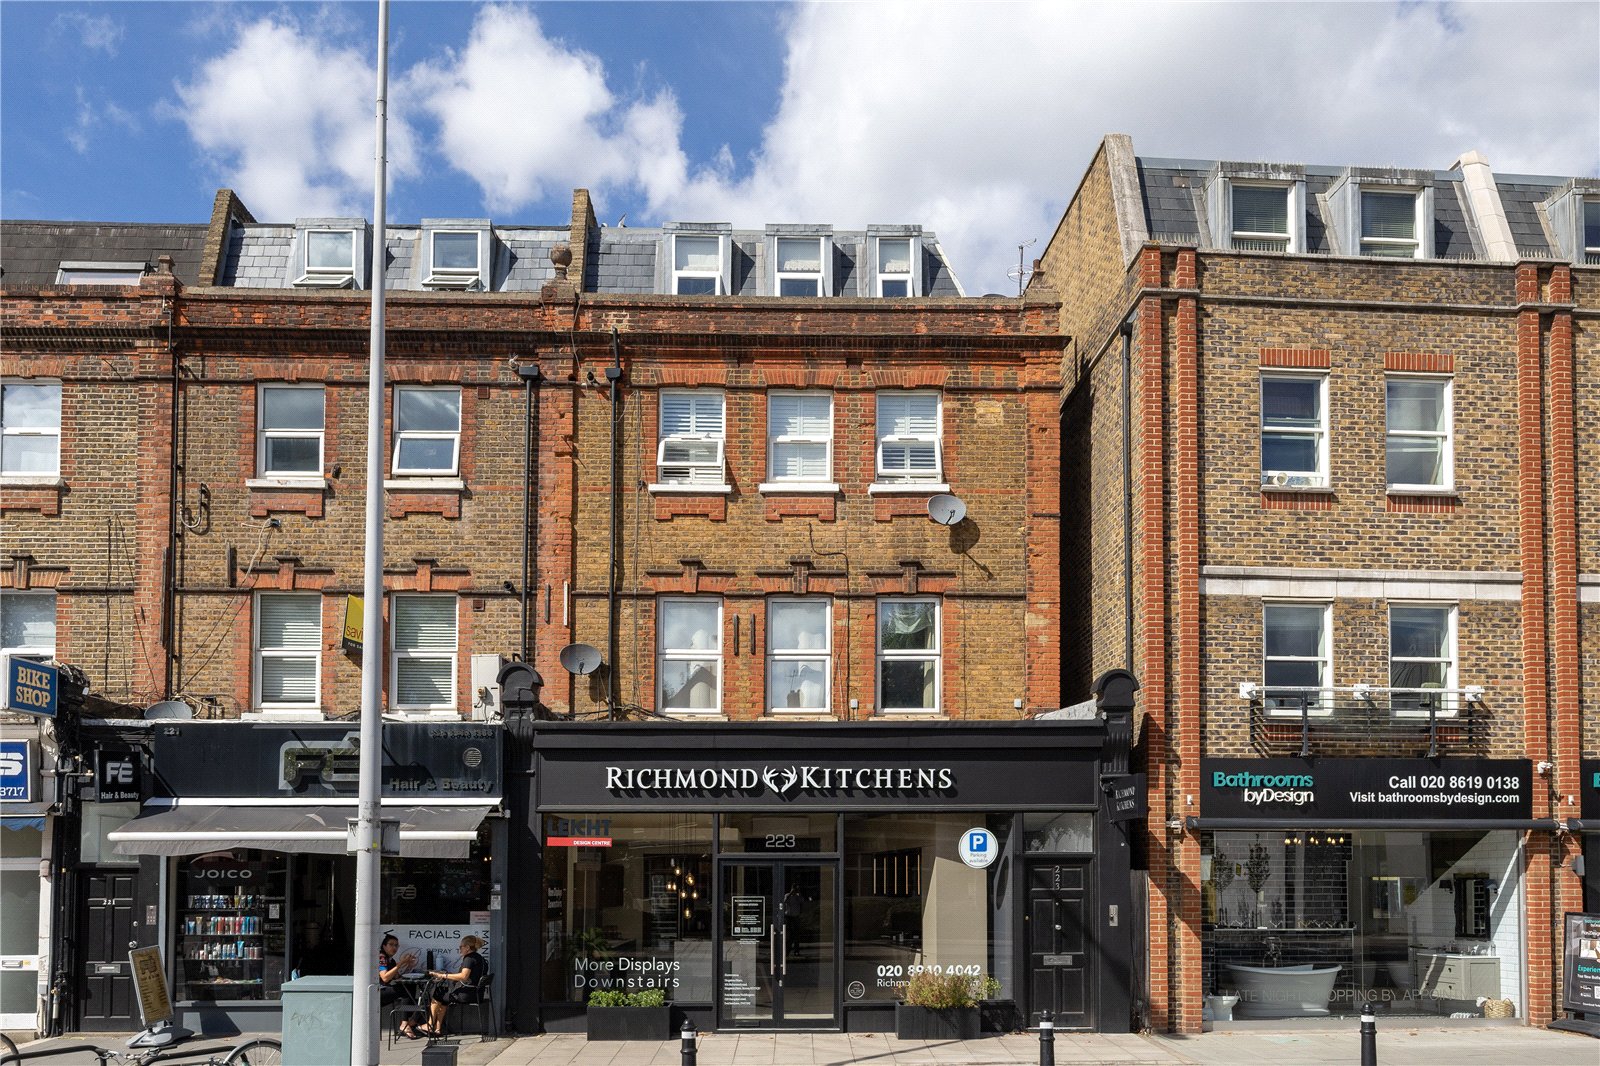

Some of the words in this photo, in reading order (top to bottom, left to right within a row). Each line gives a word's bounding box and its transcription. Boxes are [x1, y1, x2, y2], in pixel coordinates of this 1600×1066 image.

[346, 626, 363, 641] savi
[17, 666, 51, 690] BIKE
[15, 685, 51, 708] SHOP
[163, 727, 180, 735] 221
[389, 777, 420, 790] Hair
[424, 778, 437, 790] &
[441, 777, 493, 793] Beauty
[1213, 771, 1314, 787] Bathrooms
[1388, 775, 1416, 789] Call
[1420, 776, 1446, 789] 020
[1449, 776, 1483, 789] 8619
[1486, 776, 1520, 789] 0138
[101, 791, 114, 800] Hair
[114, 792, 119, 800] &
[120, 791, 139, 801] Beauty
[1243, 788, 1315, 806] byDesign
[1349, 791, 1376, 803] Visit
[1378, 791, 1520, 805] bathroomsbydesign.com
[765, 834, 796, 848] 223
[972, 835, 984, 850] P
[194, 869, 253, 879] JOICO
[408, 930, 461, 939] FACIALS
[574, 957, 614, 971] More
[618, 957, 680, 975] Displays
[877, 965, 903, 977] 020
[945, 965, 981, 977] 4042
[574, 974, 680, 988] Downstairs
[1381, 989, 1398, 1002] BY
